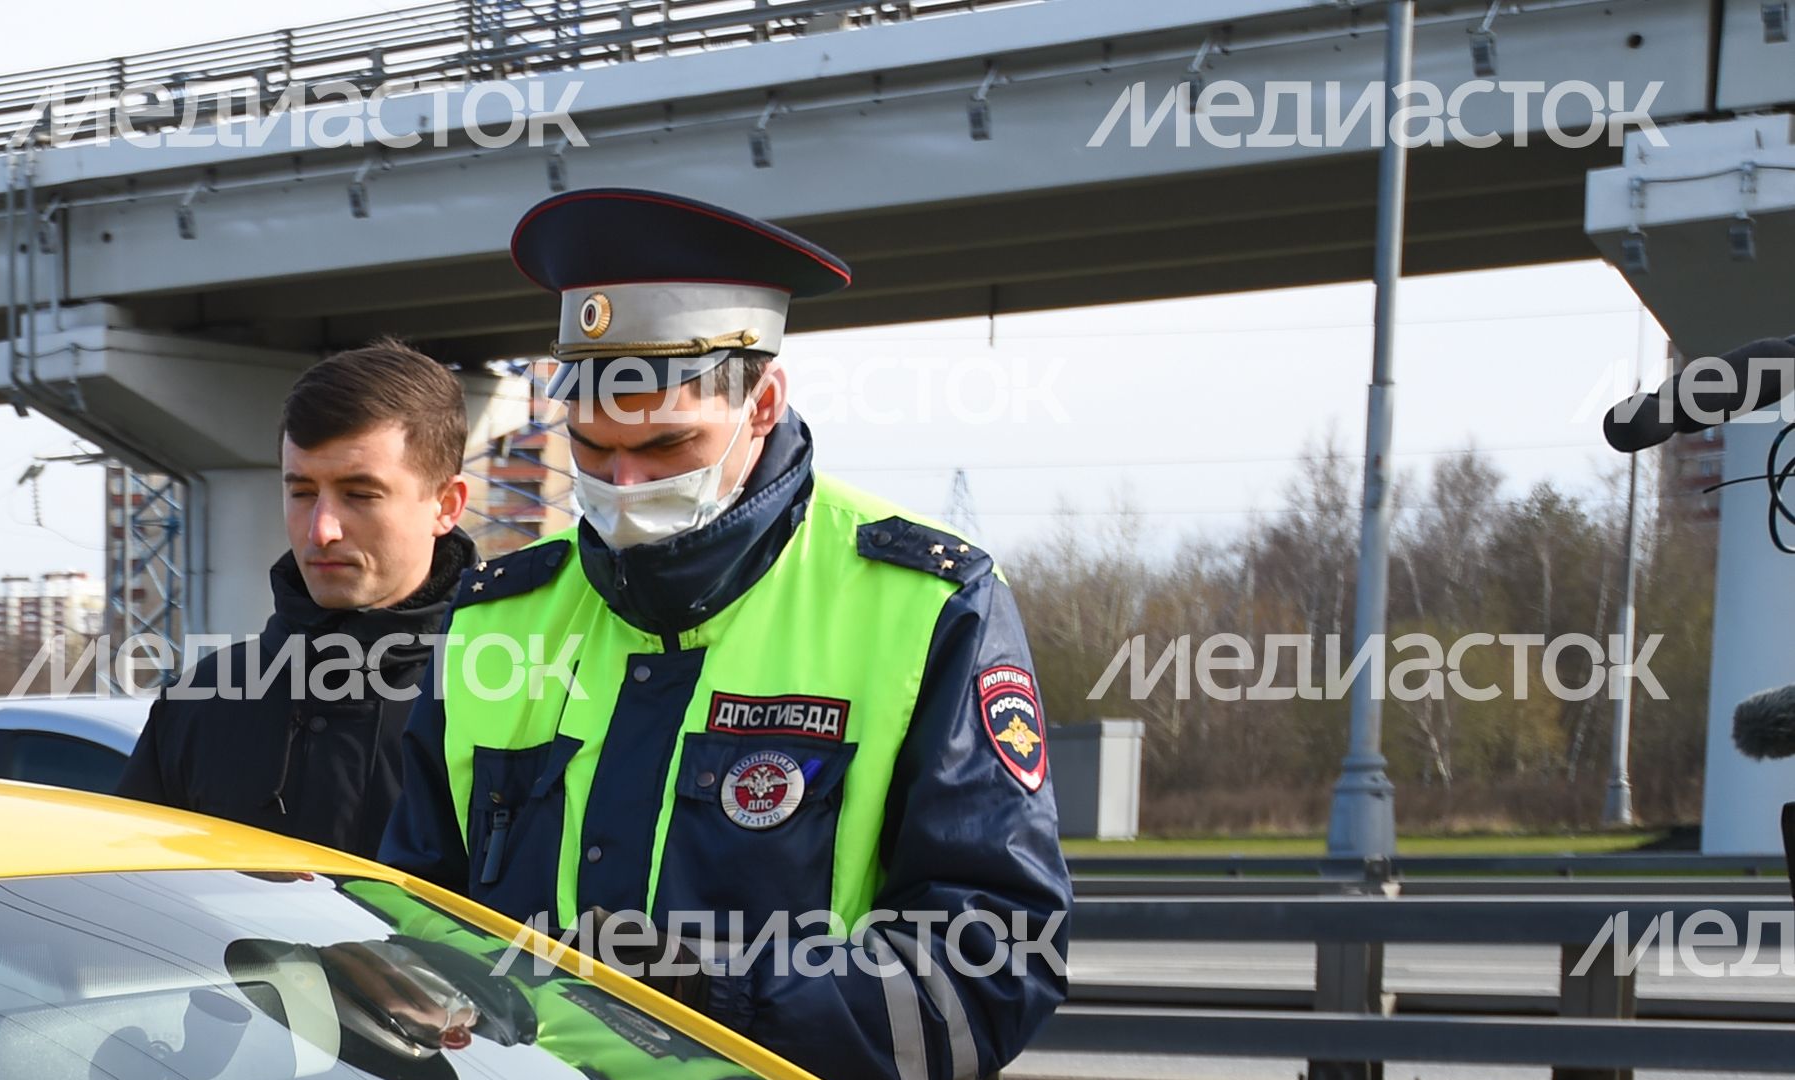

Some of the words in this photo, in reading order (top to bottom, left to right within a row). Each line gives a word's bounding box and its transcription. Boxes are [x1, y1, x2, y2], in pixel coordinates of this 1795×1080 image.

[990, 697, 1035, 719] РОССИЯ
[733, 752, 795, 775] ПОЛИЦИЯ
[746, 799, 774, 811] ДПС
